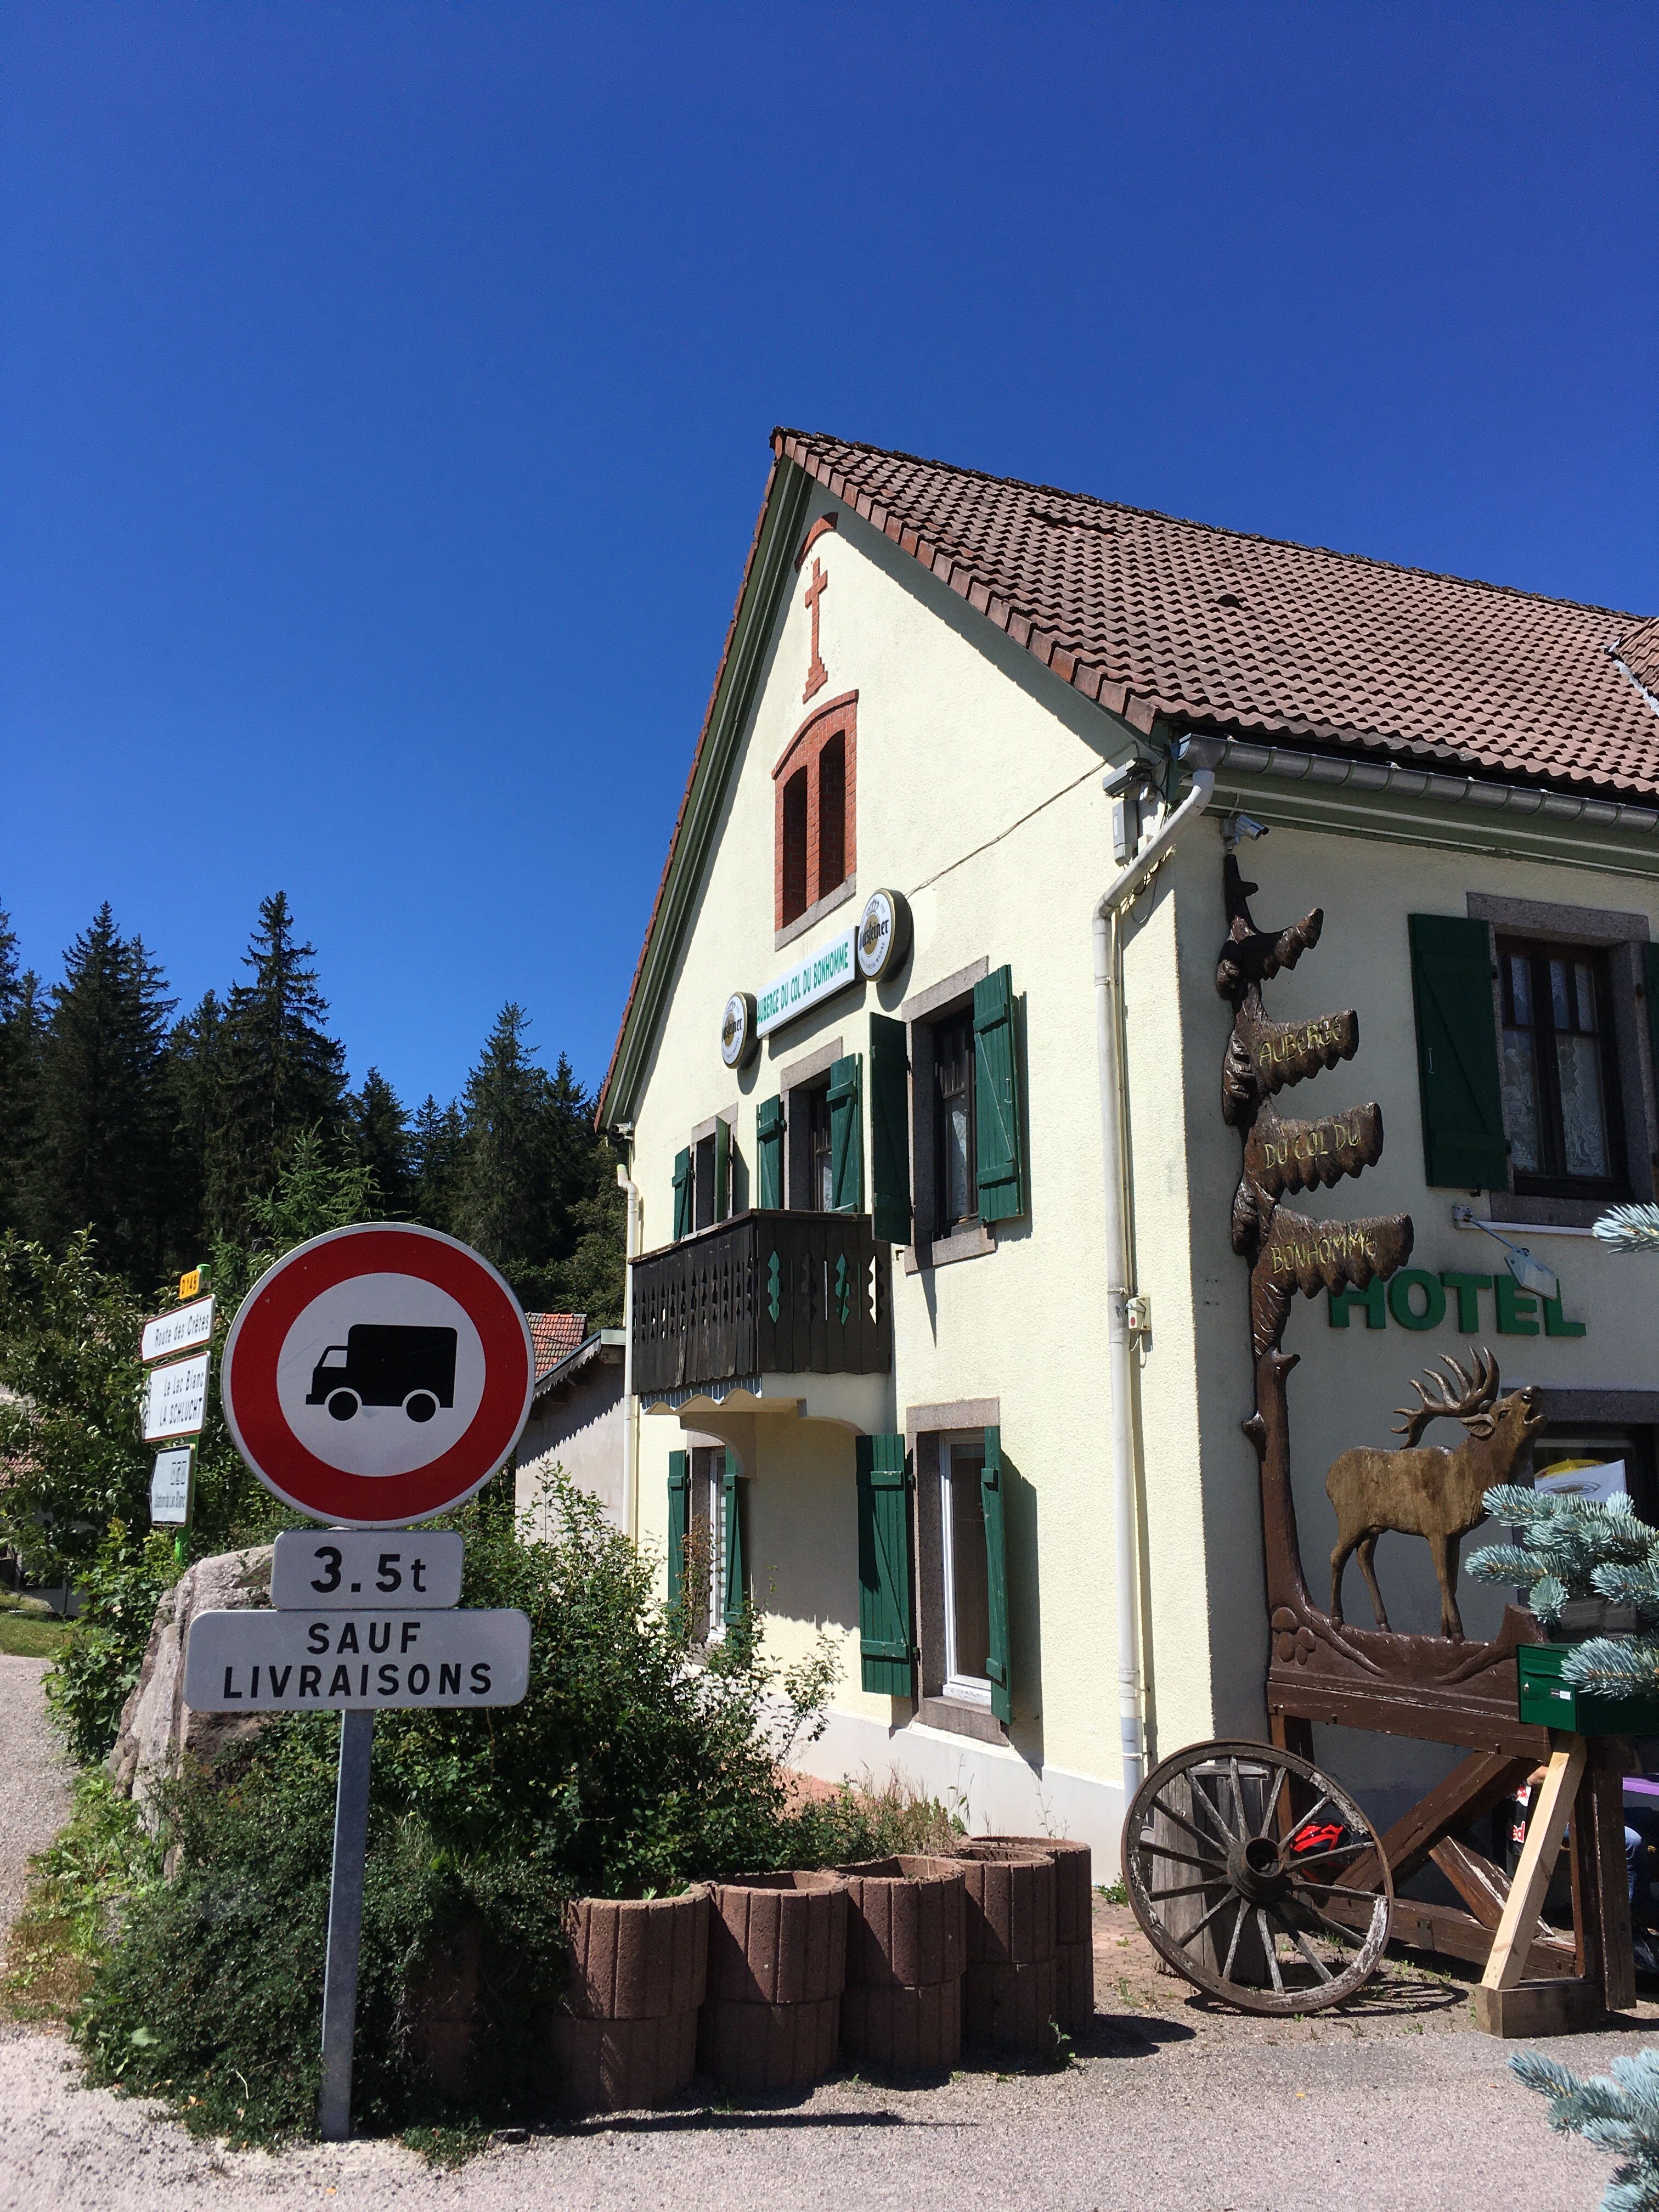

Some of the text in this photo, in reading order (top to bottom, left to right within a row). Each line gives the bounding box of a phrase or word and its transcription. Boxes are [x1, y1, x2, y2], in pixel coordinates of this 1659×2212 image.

[757, 941, 848, 1025] AUBERGE DU COL DU BONHOMME
[1265, 1120, 1361, 1169] DU COL DU
[182, 1274, 197, 1295] D 148
[1328, 1268, 1586, 1336] HOTEL
[154, 1313, 209, 1347] Route des Crêtes
[164, 1377, 171, 1397] Le
[173, 1374, 183, 1395] Lac
[185, 1369, 204, 1391] Blanc
[159, 1406, 167, 1426] LA
[169, 1397, 202, 1425] SCHLUCHT
[310, 1546, 426, 1593] 3.5t
[306, 1622, 421, 1655] SAUF
[223, 1662, 492, 1699] LIVRAISONS
